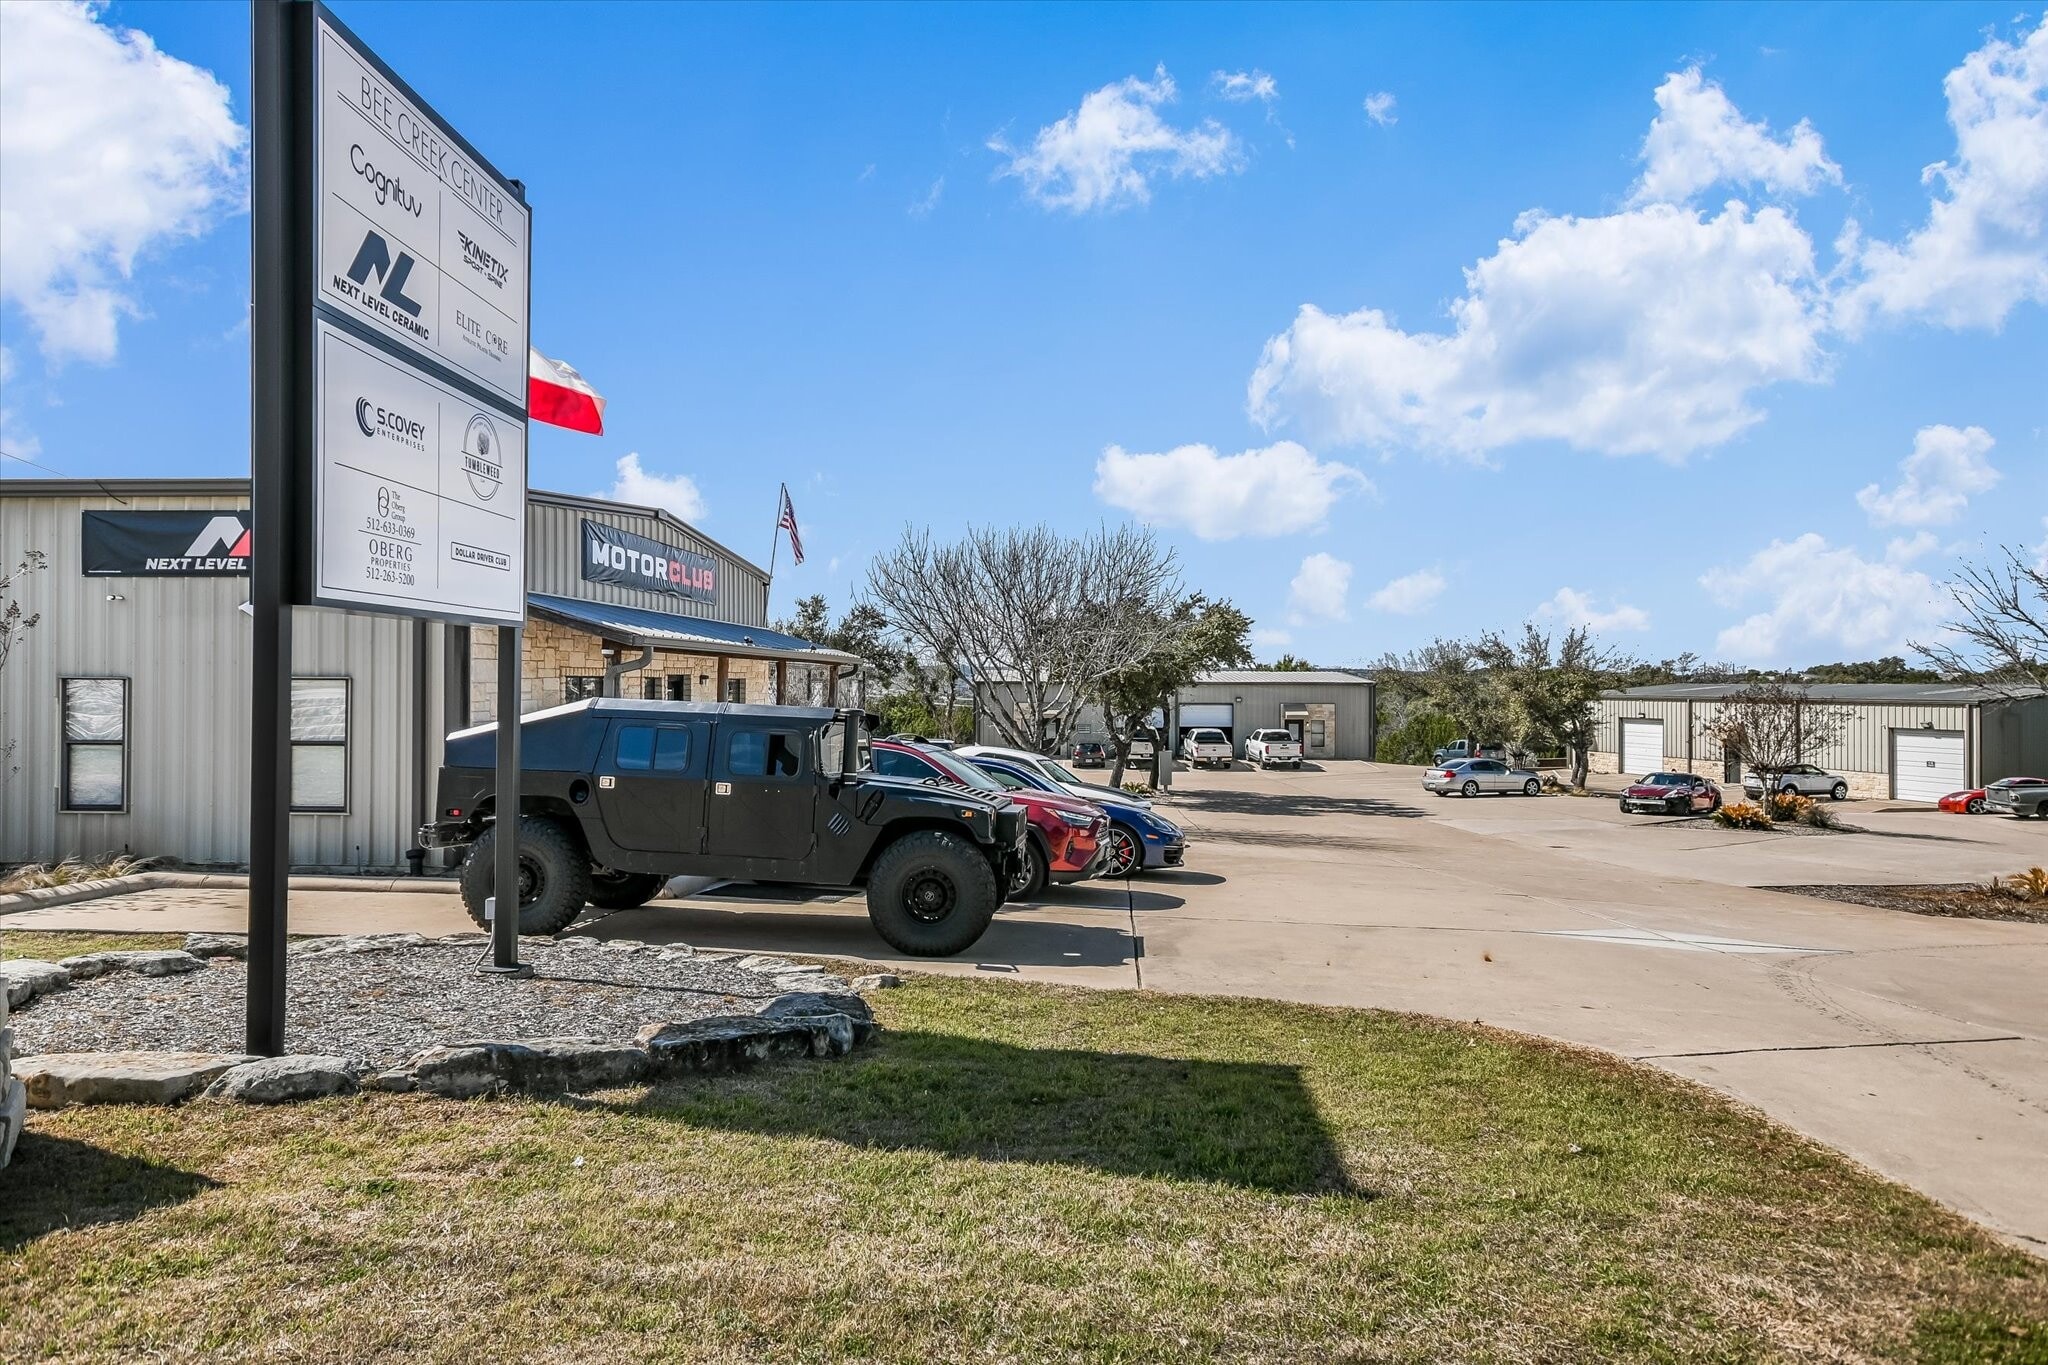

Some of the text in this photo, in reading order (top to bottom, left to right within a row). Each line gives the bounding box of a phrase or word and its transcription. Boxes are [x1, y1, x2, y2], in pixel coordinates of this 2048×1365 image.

[361, 76, 503, 225] BEE CREEK CENTER
[350, 143, 422, 218] Cognituv
[459, 232, 509, 283] KINETIX
[463, 254, 483, 274] SPORT
[333, 275, 430, 340] NEXT LEVEL CERAMIC
[456, 309, 481, 339] ELITE
[377, 407, 425, 441] S.COVEY
[377, 427, 425, 452] ENTERPRISES
[465, 456, 500, 480] TUMBLEWEED
[391, 490, 401, 501] The
[391, 501, 406, 514] Oberg
[391, 511, 406, 524] Group
[366, 516, 415, 539] 512-633-0369
[369, 538, 413, 562] OBERG
[455, 547, 507, 566] DOLLAR DRIVER CLUB
[145, 558, 247, 570] NEXT LEVEL
[370, 556, 411, 572] PROPERTIES
[366, 566, 415, 586] 512-263-5200
